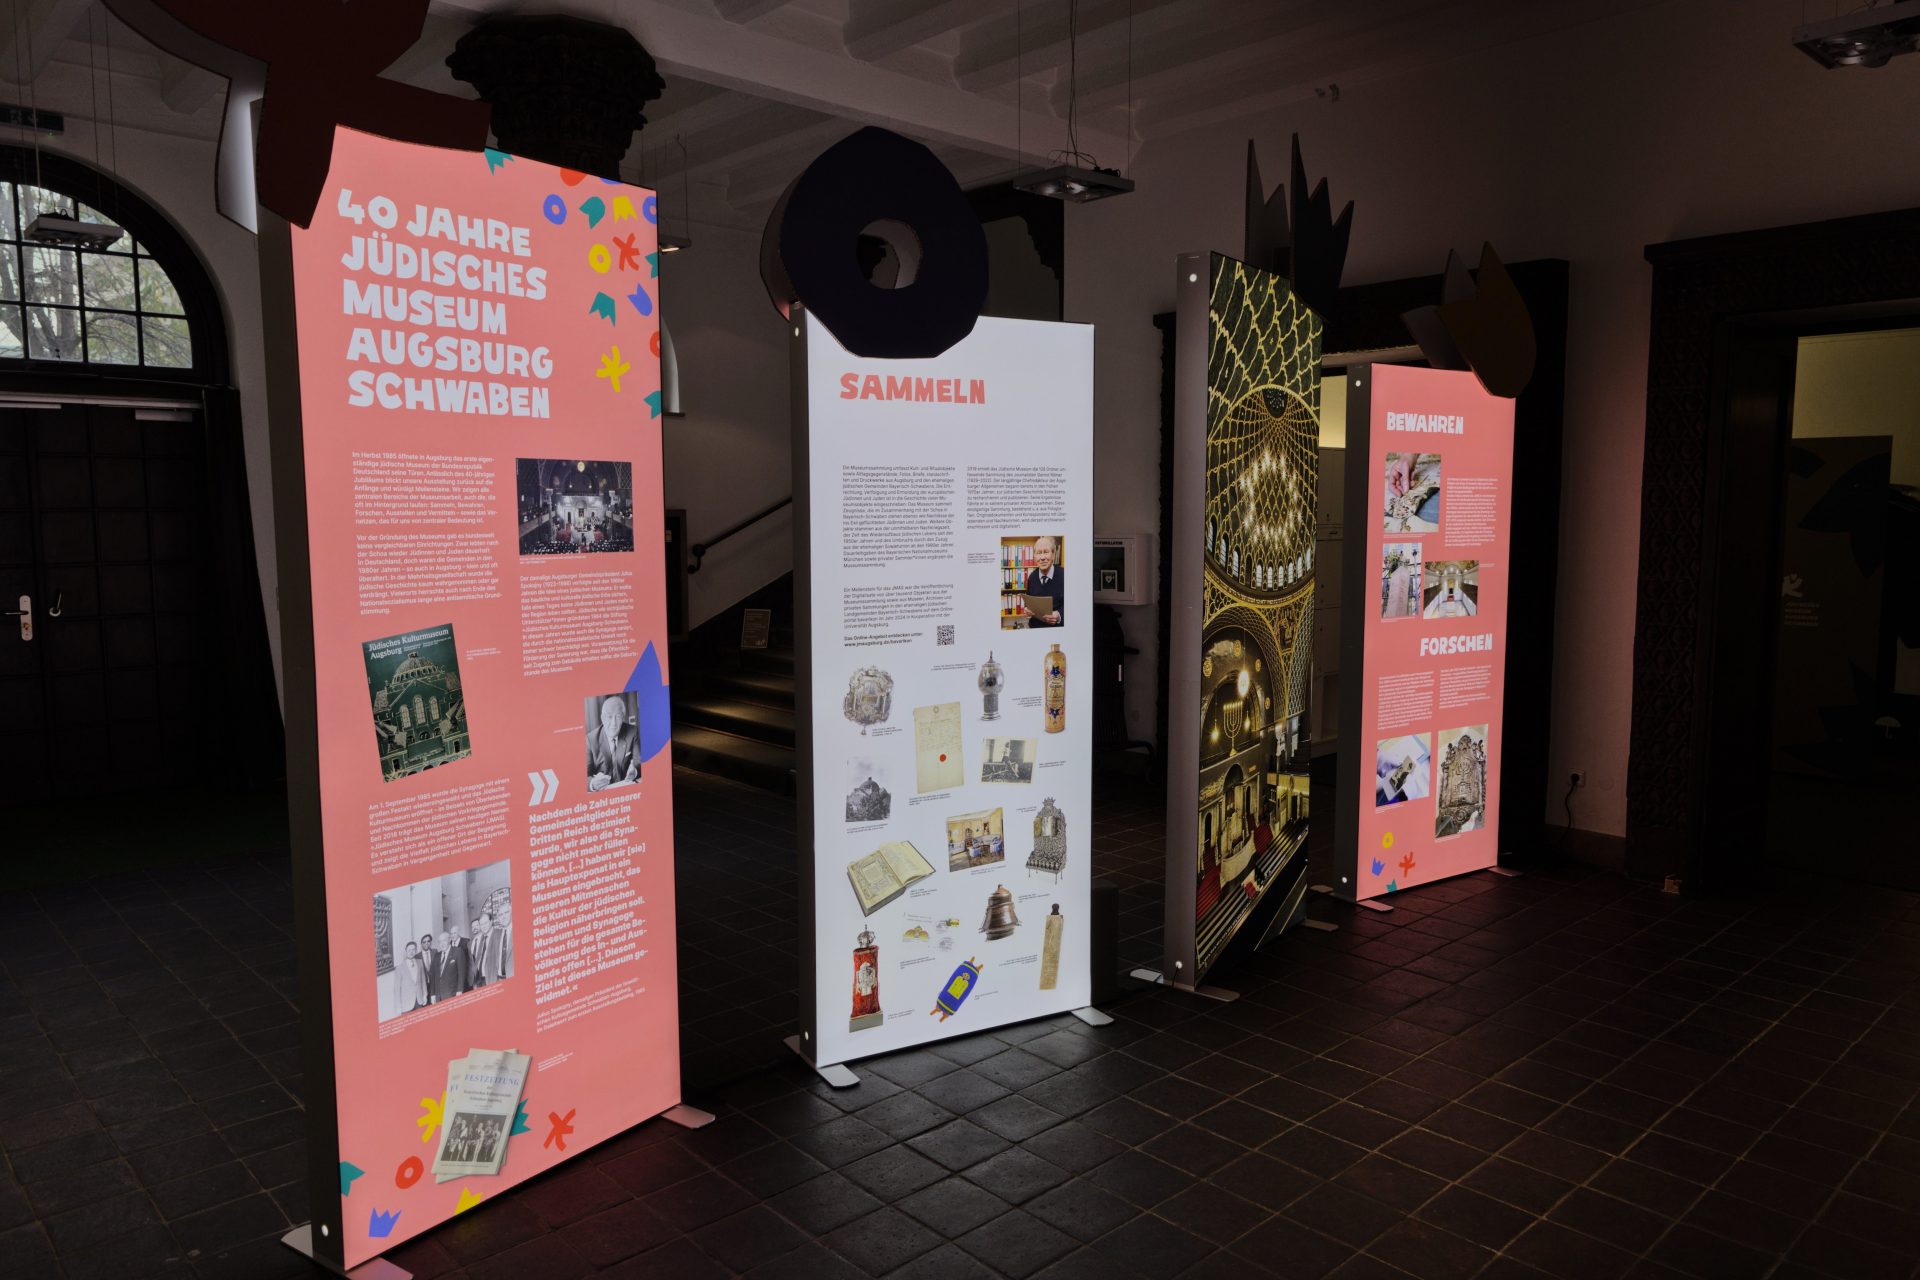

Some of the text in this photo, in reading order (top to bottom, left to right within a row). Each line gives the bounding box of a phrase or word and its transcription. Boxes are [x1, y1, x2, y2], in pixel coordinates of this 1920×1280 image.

[338, 189, 531, 257] 40 JAHRE
[341, 231, 547, 300] JÜDISCHES
[343, 279, 507, 335] MUSEUM
[346, 328, 553, 379] AUGSBURG
[348, 370, 550, 418] SCHWABEN
[840, 372, 985, 404] SAMMELN
[1387, 412, 1463, 434] BEWAHREN
[369, 640, 400, 651] Jüdisches
[401, 629, 448, 644] Kulturmuseum
[370, 648, 402, 659] Augsburg
[1420, 633, 1492, 656] FORSCHEN
[529, 792, 641, 824] Nachdem die Zahl unserer
[529, 805, 631, 835] Gemeindemitglieder im
[530, 815, 630, 847] Dritten Reich dezimiert
[530, 825, 638, 858] wurde, wir also die Syna-
[530, 838, 628, 872] goge nicht mehr füllen
[531, 866, 567, 881] können,
[585, 854, 612, 866] haben
[613, 848, 626, 858] wir
[627, 842, 646, 856] [sie]
[531, 858, 631, 892] als Hauptexponat in ein
[532, 866, 641, 904] Museum eingebracht, das
[532, 880, 630, 915] unseren Mitmenschen
[533, 889, 635, 926] die Kultur der jüdischen
[533, 896, 645, 938] Religion näherbringen soll.
[533, 911, 634, 949] Museum und Synagoge
[534, 919, 646, 960] stehen für die gesamte Be-
[534, 951, 579, 971] völkerung
[580, 945, 597, 955] des
[610, 933, 626, 945] und
[628, 929, 648, 940] Aus-
[535, 968, 560, 983] lands
[562, 960, 585, 973] offen
[605, 942, 636, 958] Diesem
[535, 949, 648, 994] Ziel ist dieses Museum ge-
[465, 1074, 519, 1086] FESTZEITUNG
